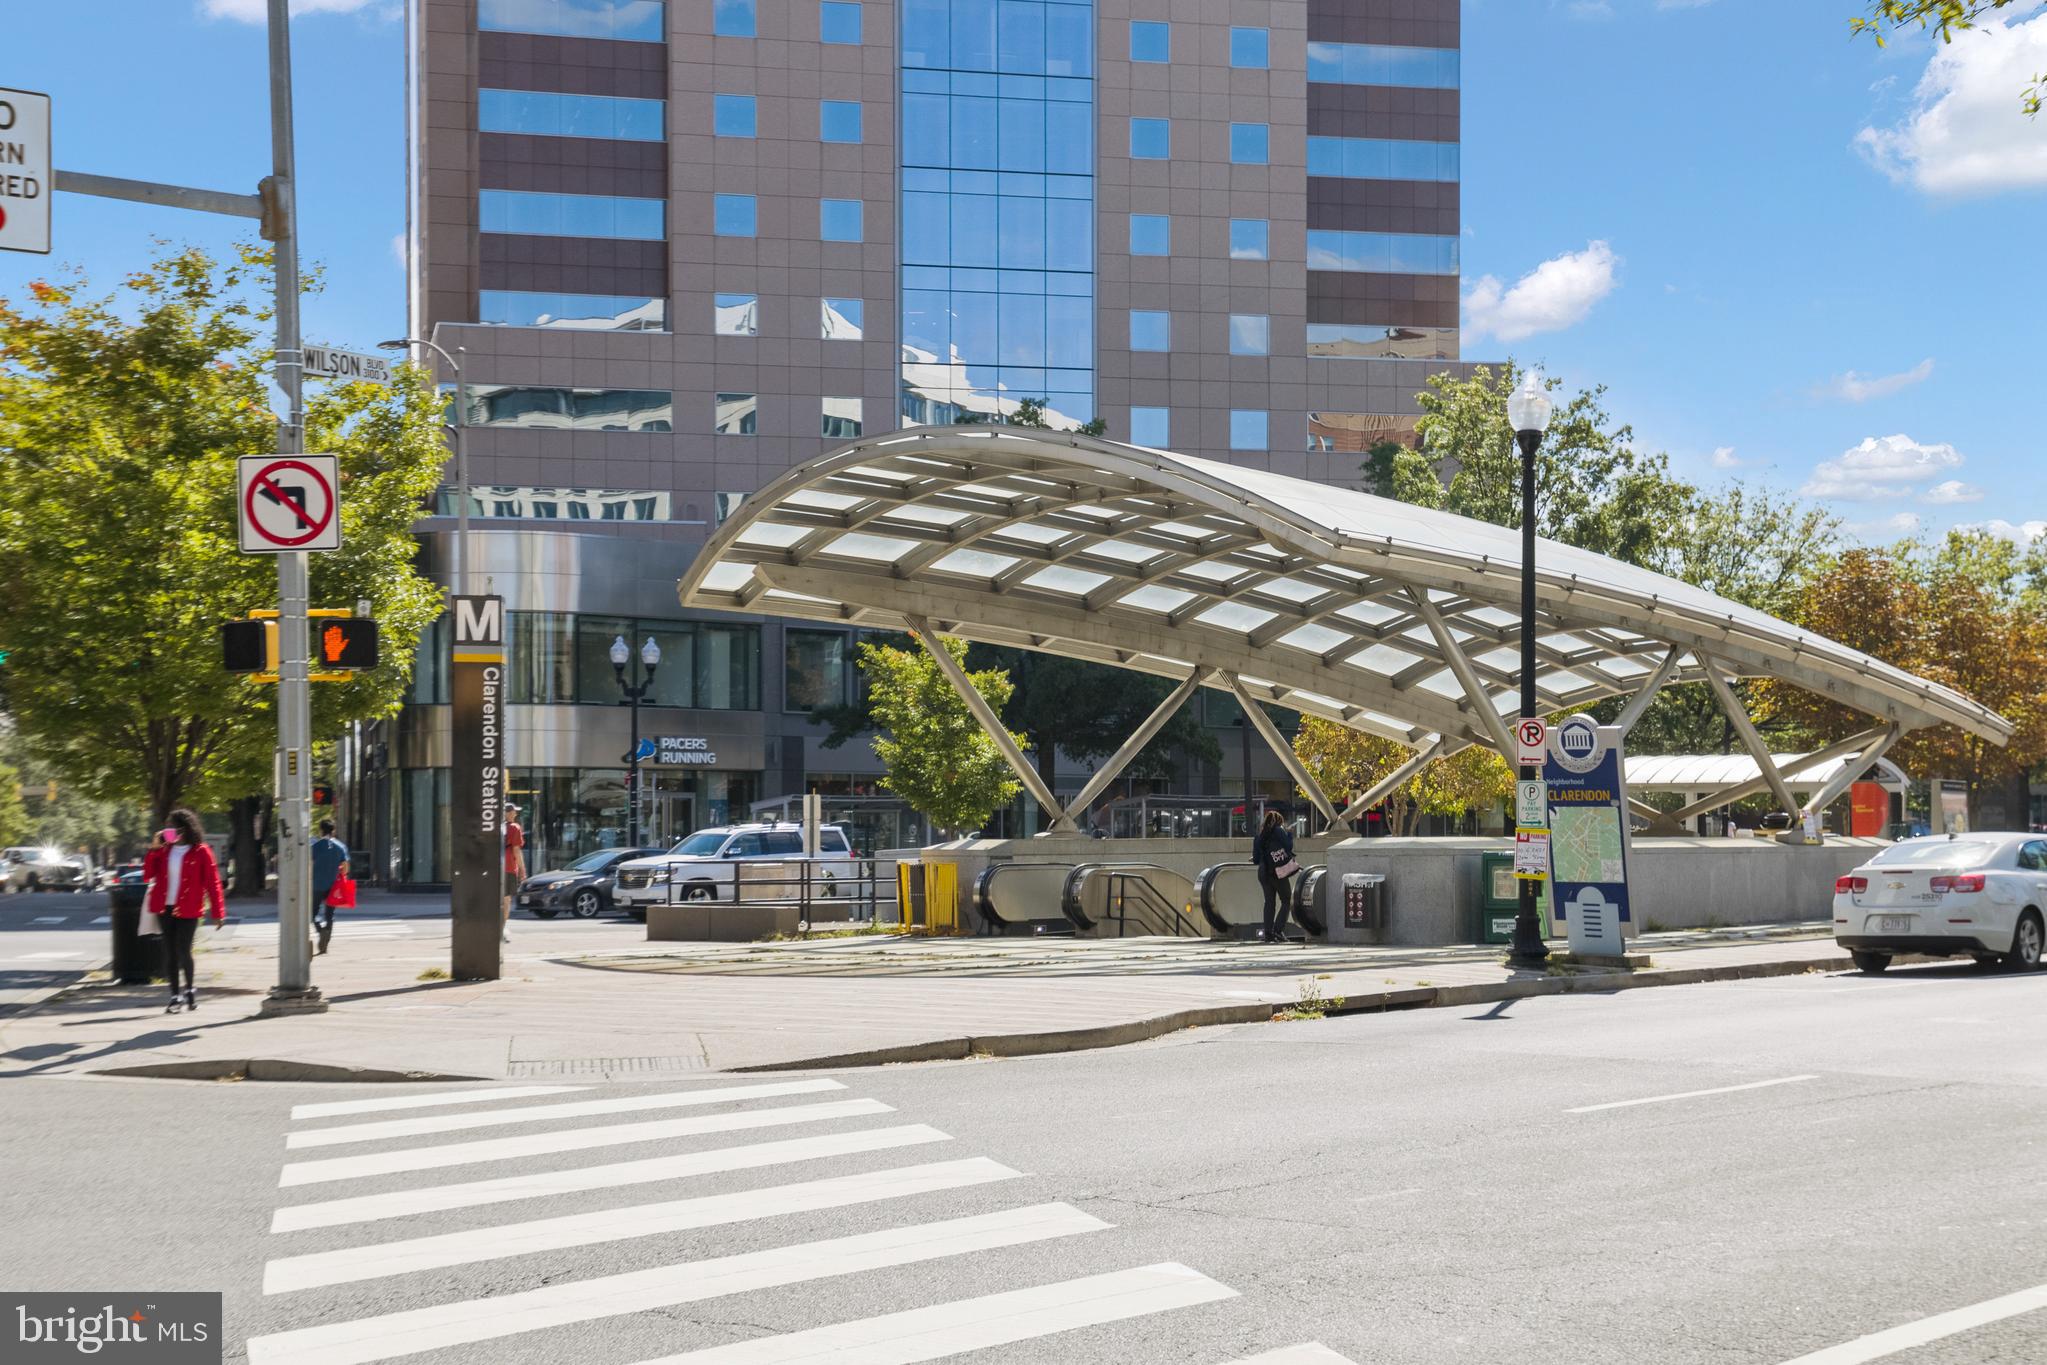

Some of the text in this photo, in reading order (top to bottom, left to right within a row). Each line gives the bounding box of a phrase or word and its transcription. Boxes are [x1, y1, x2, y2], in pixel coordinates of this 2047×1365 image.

[0, 175, 40, 199] ED
[303, 348, 360, 377] WILSON
[366, 358, 384, 370] BLVD
[363, 368, 379, 380] 3100
[456, 599, 500, 641] M
[481, 667, 500, 832] Clarendon Station
[661, 737, 707, 750] PACERS
[662, 752, 717, 764] RUNNING
[1546, 778, 1585, 786] Neighborhood
[1547, 789, 1611, 801] CLARENDON
